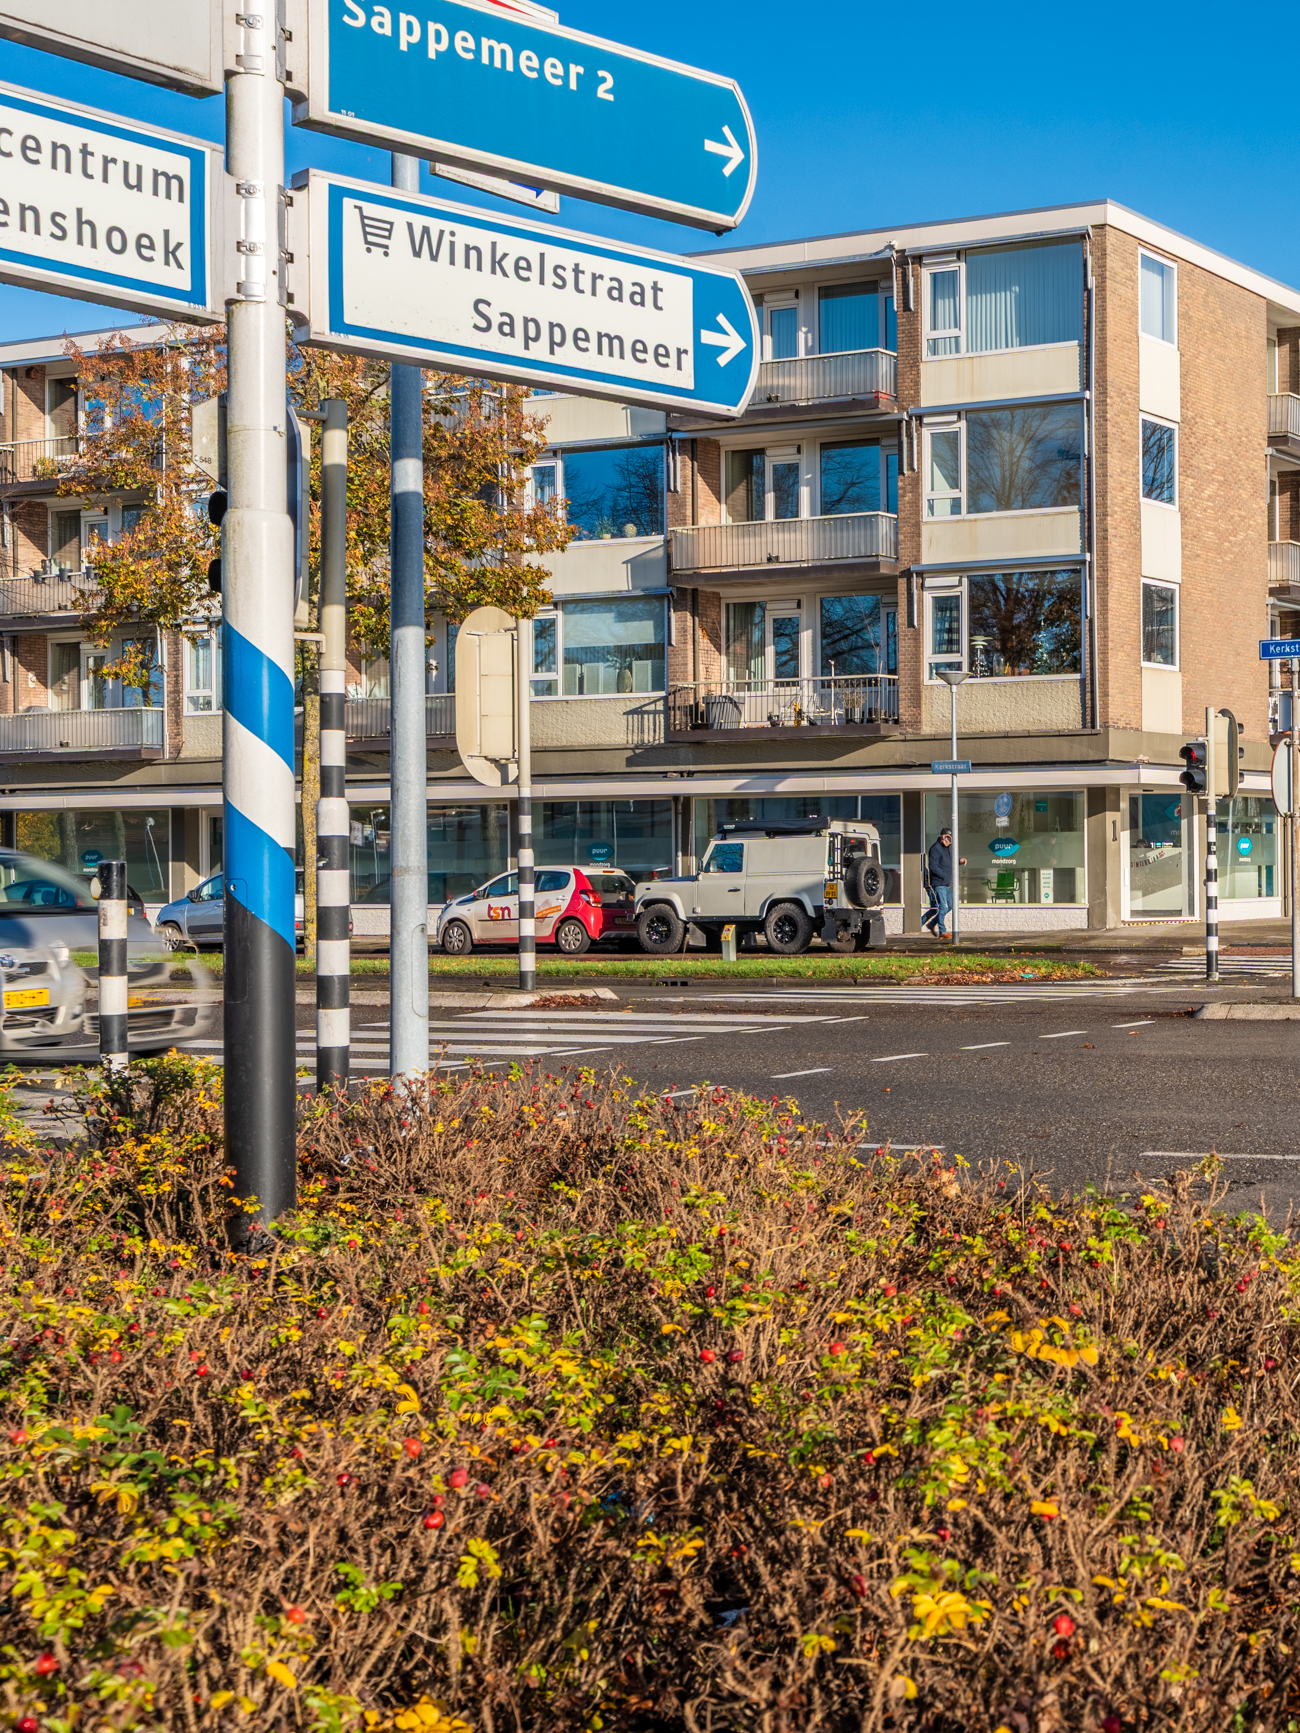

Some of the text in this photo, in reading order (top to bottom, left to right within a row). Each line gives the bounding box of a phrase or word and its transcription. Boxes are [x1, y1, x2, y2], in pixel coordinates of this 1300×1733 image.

[342, 0, 615, 102] Sappemeer 2
[406, 220, 664, 311] Winkelstraat
[471, 298, 690, 372] Sappemeer
[934, 763, 967, 771] Kerkstraat
[487, 903, 511, 919] tsn
